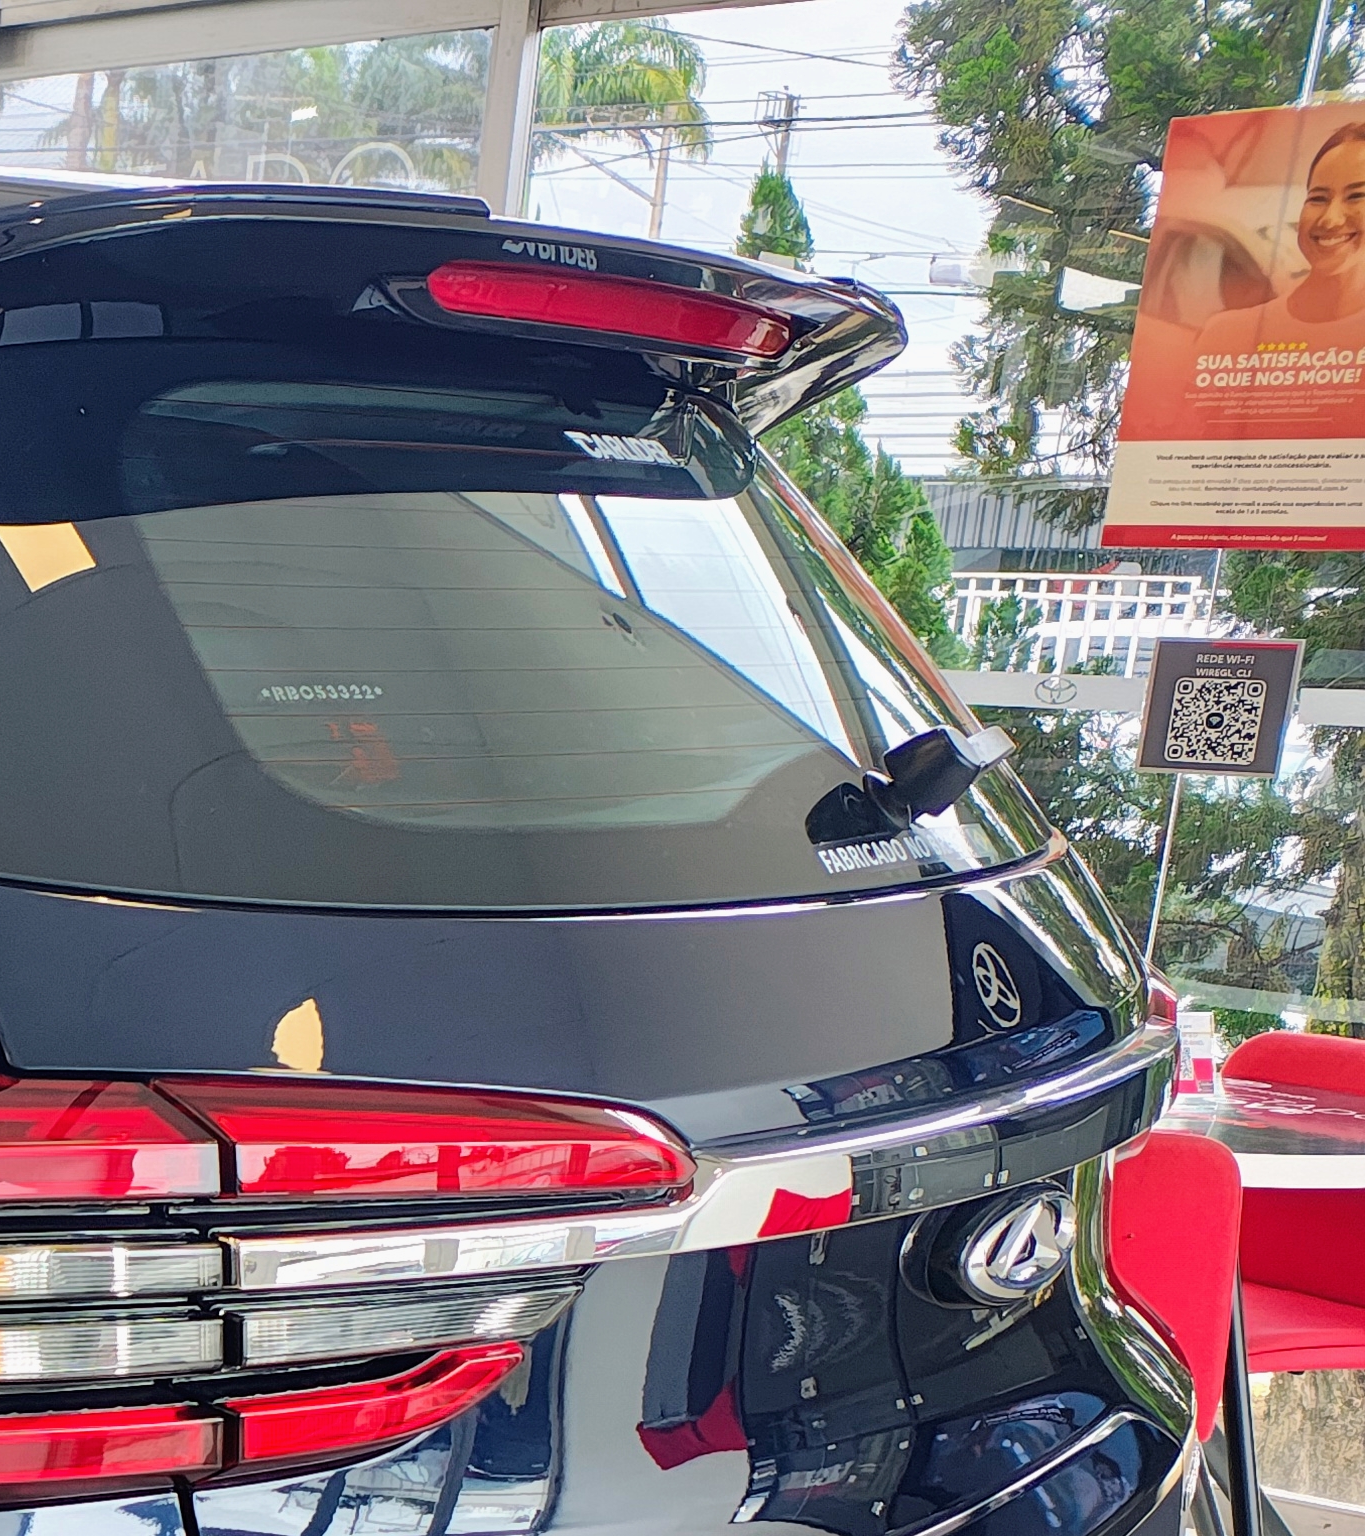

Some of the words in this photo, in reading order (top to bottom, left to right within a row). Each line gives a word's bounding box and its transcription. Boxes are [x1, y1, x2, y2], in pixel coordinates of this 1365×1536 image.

[1195, 353, 1233, 370] SUA
[1235, 346, 1354, 372] SATISFAÇÃO
[1195, 373, 1211, 388] O
[1213, 371, 1252, 387] QUE
[1254, 370, 1295, 386] NOS
[1297, 368, 1361, 386] MOVE!
[1196, 653, 1224, 665] REDE
[1226, 654, 1255, 666] WI-FI
[818, 839, 907, 875] FABRICADO
